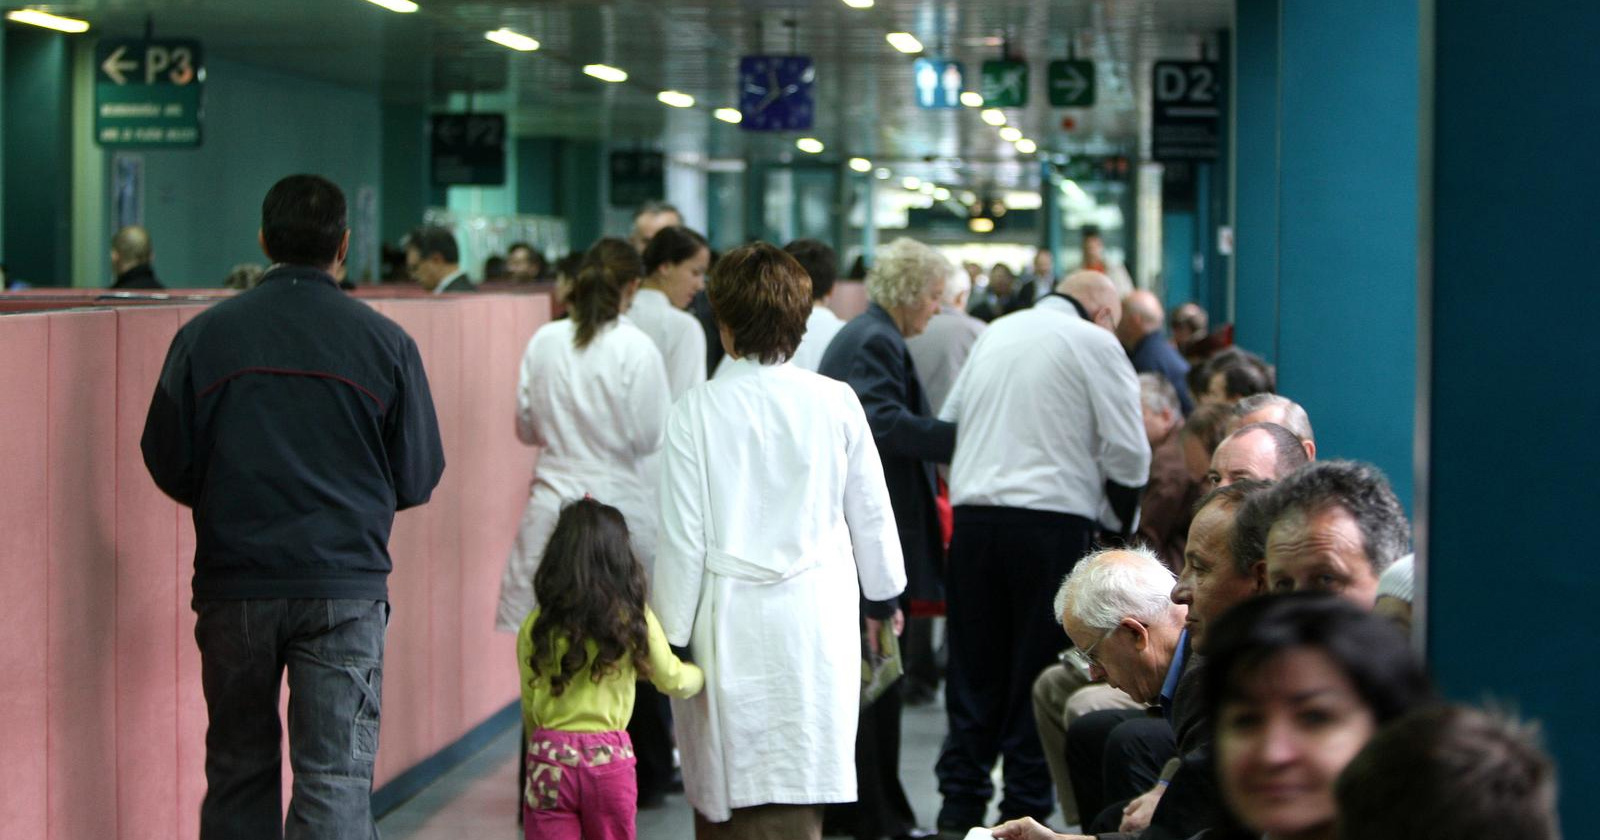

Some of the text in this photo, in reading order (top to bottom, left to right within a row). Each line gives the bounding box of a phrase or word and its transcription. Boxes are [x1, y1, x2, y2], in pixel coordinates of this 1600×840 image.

[145, 46, 194, 86] P3
[1156, 65, 1214, 100] D2
[466, 116, 499, 146] P2
